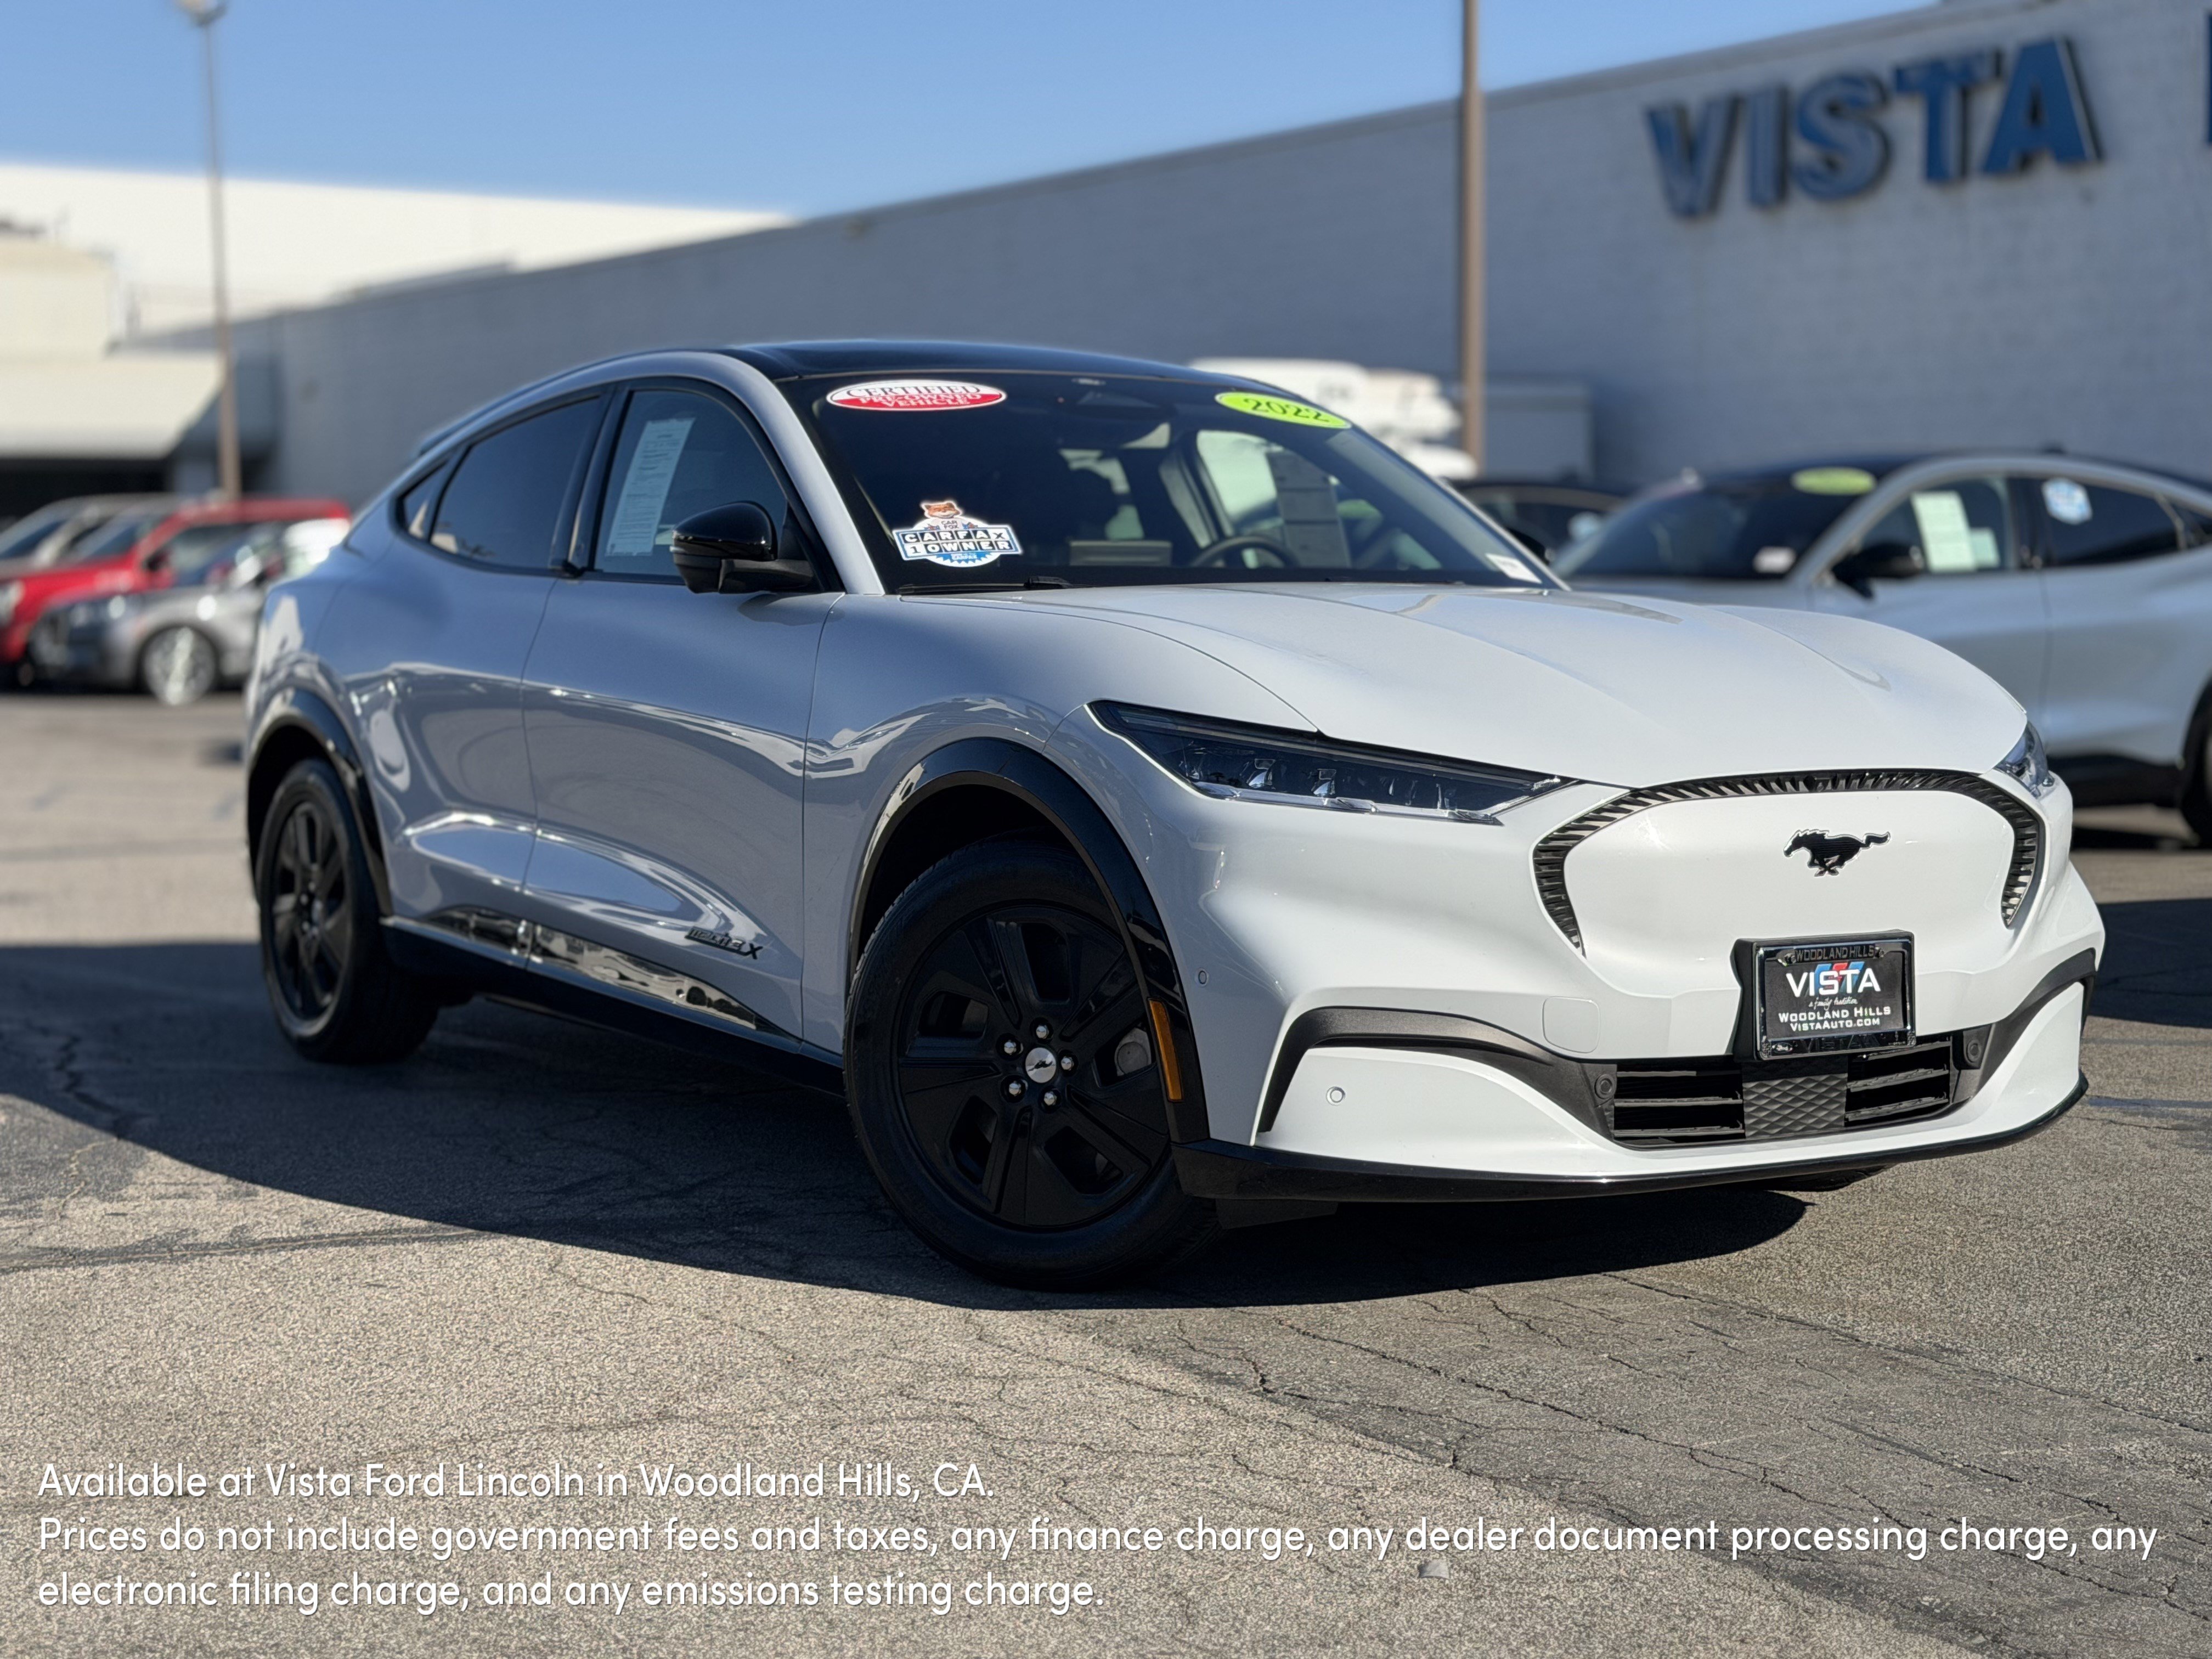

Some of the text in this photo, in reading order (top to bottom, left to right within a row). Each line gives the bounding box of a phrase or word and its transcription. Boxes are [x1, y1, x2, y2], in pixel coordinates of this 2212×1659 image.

[1645, 34, 2106, 217] VISTA
[847, 386, 981, 398] CERTIFIED
[858, 393, 982, 403] PRE-OWNED
[881, 398, 970, 407] VEHICLE
[1243, 398, 1329, 422] 2022
[903, 530, 1005, 543] CARFAX
[909, 541, 1011, 554] 1 OWNER
[1796, 945, 1875, 961] WOODLAND HILLS
[1785, 968, 1881, 998] VISTA
[1778, 1006, 1891, 1023] WOODLAND HILLS
